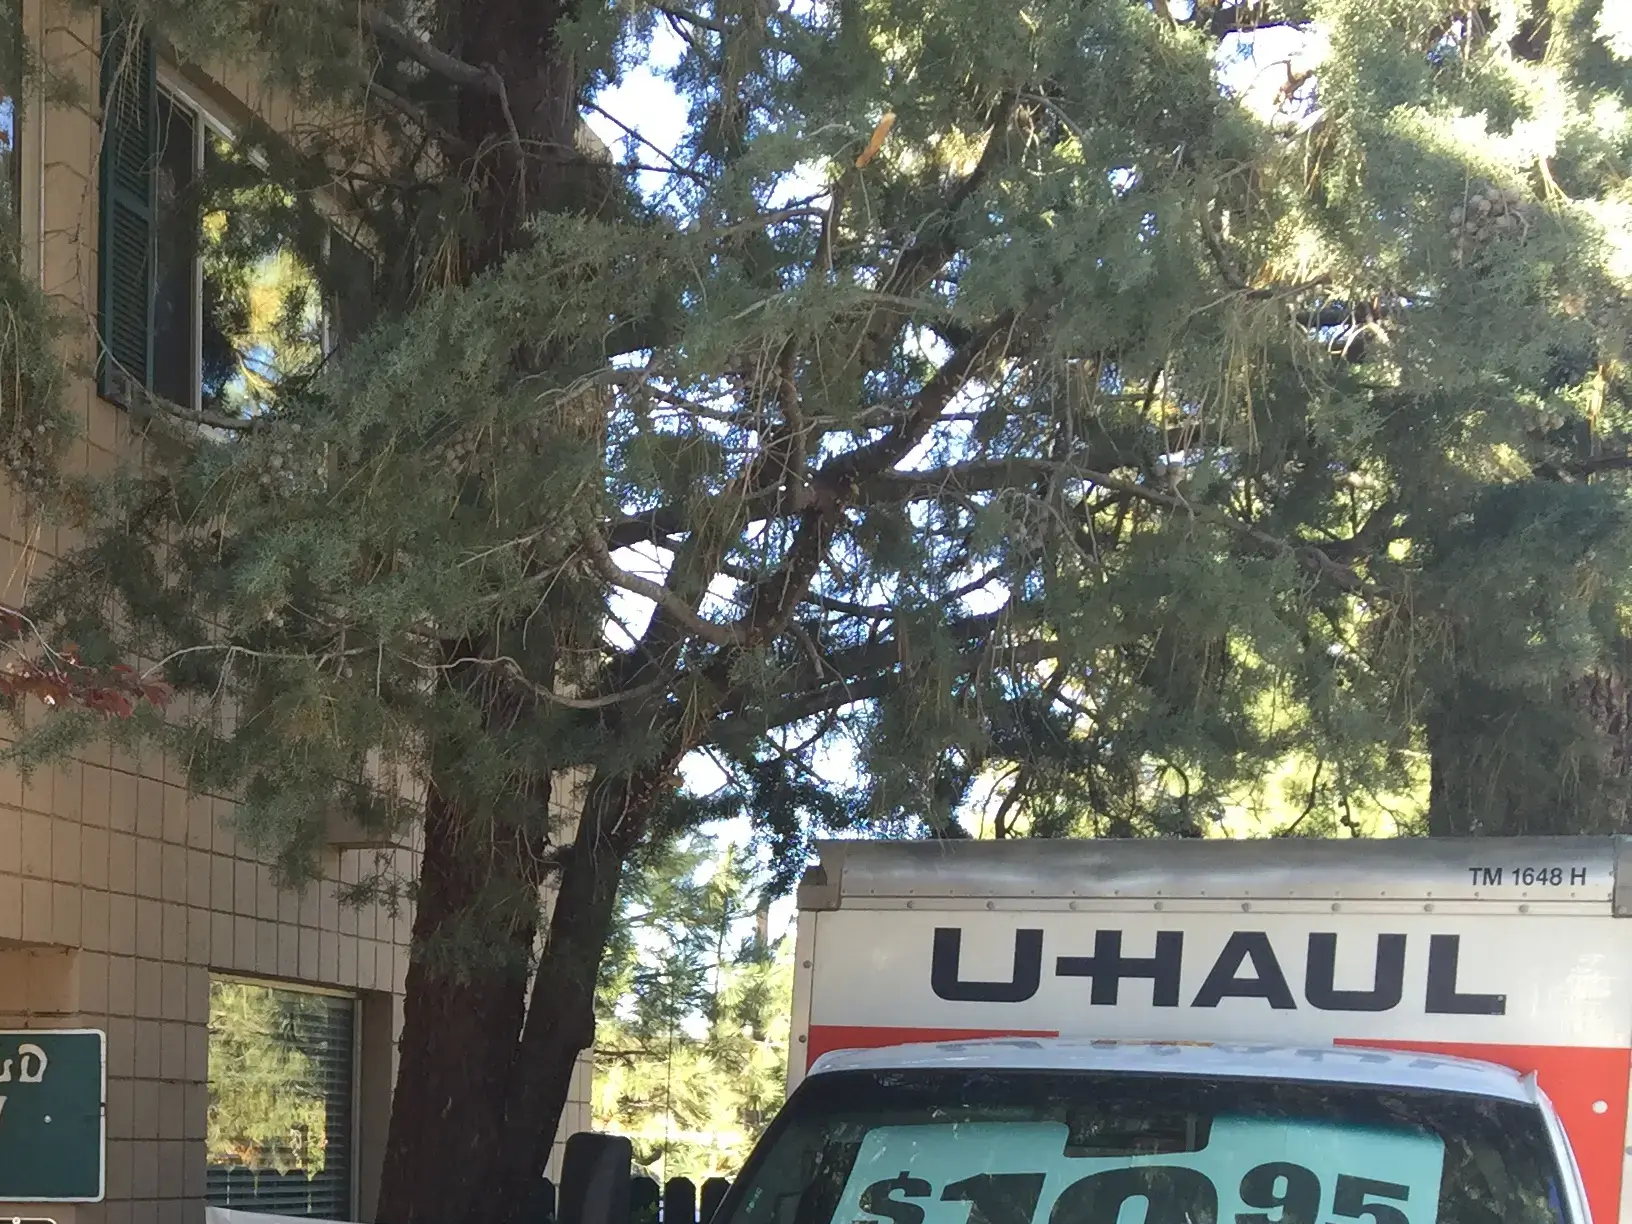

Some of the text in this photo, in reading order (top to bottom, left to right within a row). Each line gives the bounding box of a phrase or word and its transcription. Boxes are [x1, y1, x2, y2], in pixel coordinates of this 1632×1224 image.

[1468, 867, 1587, 886] TM 1648 H
[930, 926, 1507, 1017] U-HAUL
